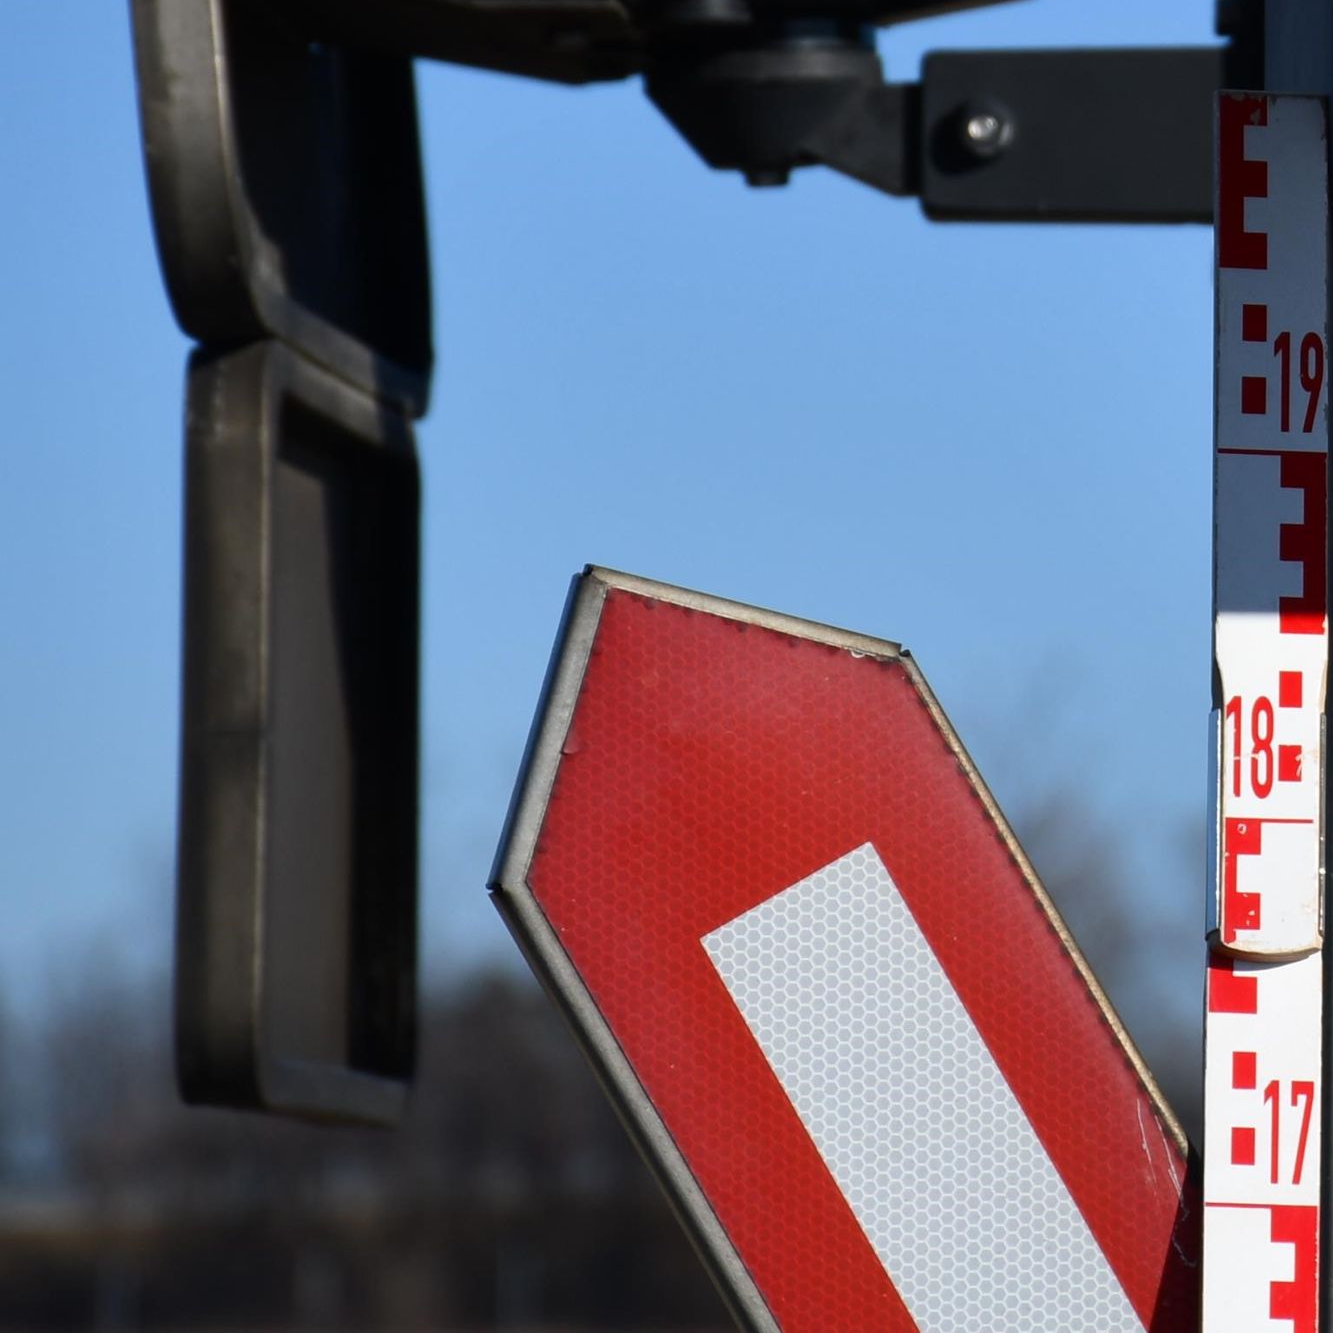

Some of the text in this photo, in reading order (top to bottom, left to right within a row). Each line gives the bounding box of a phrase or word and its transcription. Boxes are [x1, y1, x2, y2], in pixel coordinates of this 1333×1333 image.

[1274, 331, 1324, 433] 19
[1226, 695, 1274, 799] 18
[1264, 1080, 1314, 1185] 17
